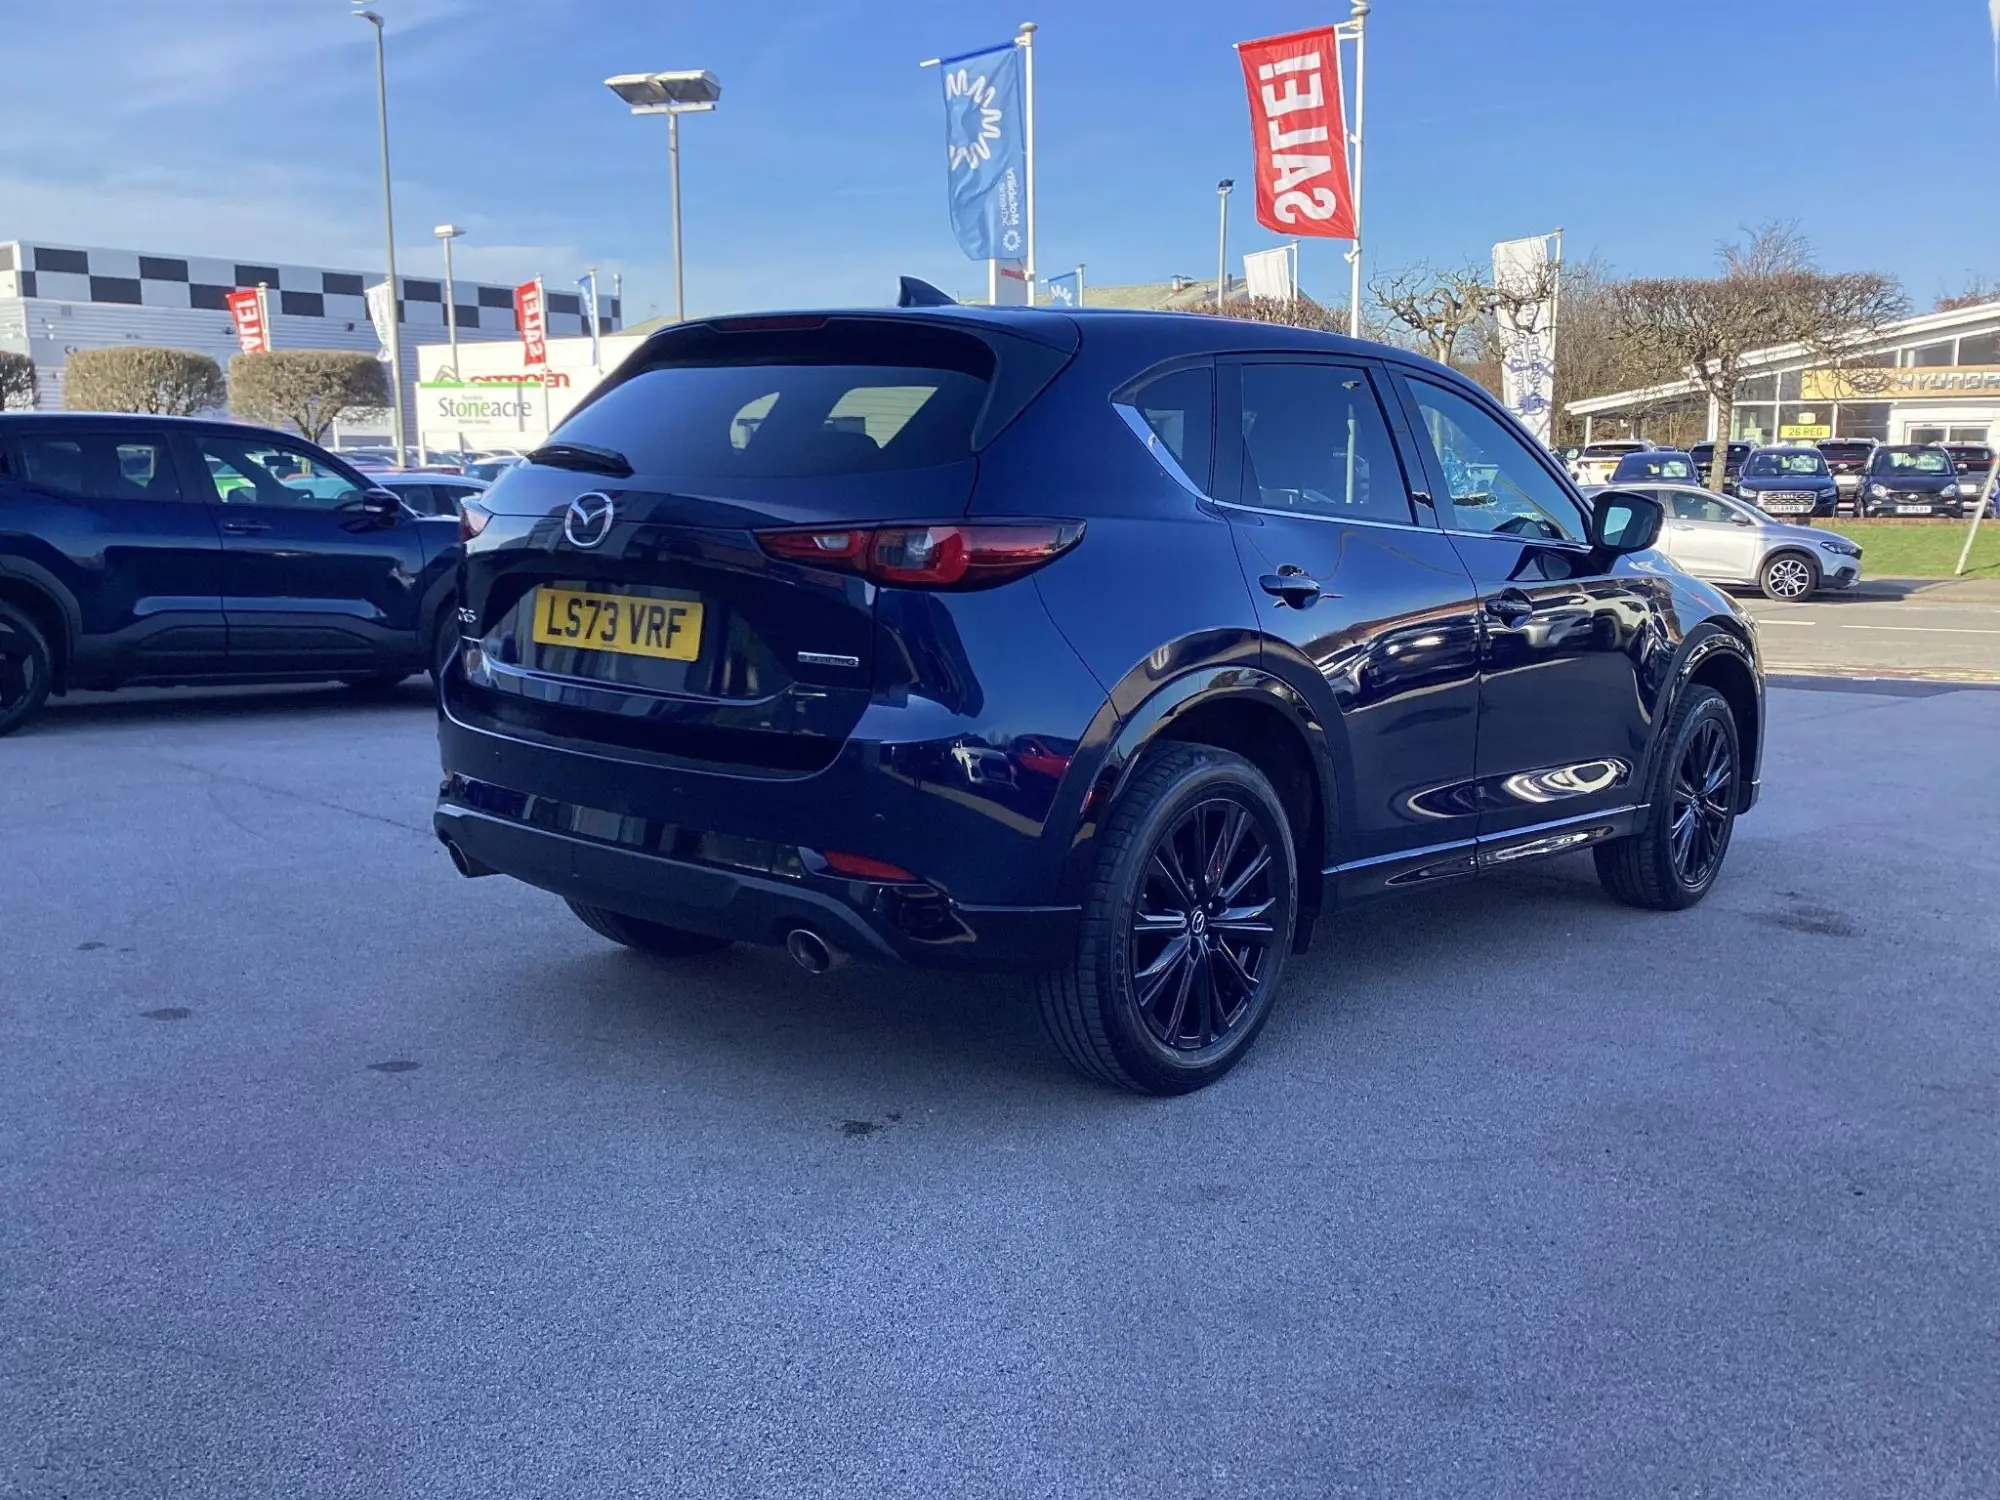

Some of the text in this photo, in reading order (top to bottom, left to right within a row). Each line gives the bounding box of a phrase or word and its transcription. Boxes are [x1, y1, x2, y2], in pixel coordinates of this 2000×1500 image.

[1899, 371, 2000, 391] HYUNDA
[438, 396, 532, 418] Stoneacre
[1788, 427, 1823, 437] 26 REG
[547, 596, 687, 649] LS73 VRF
